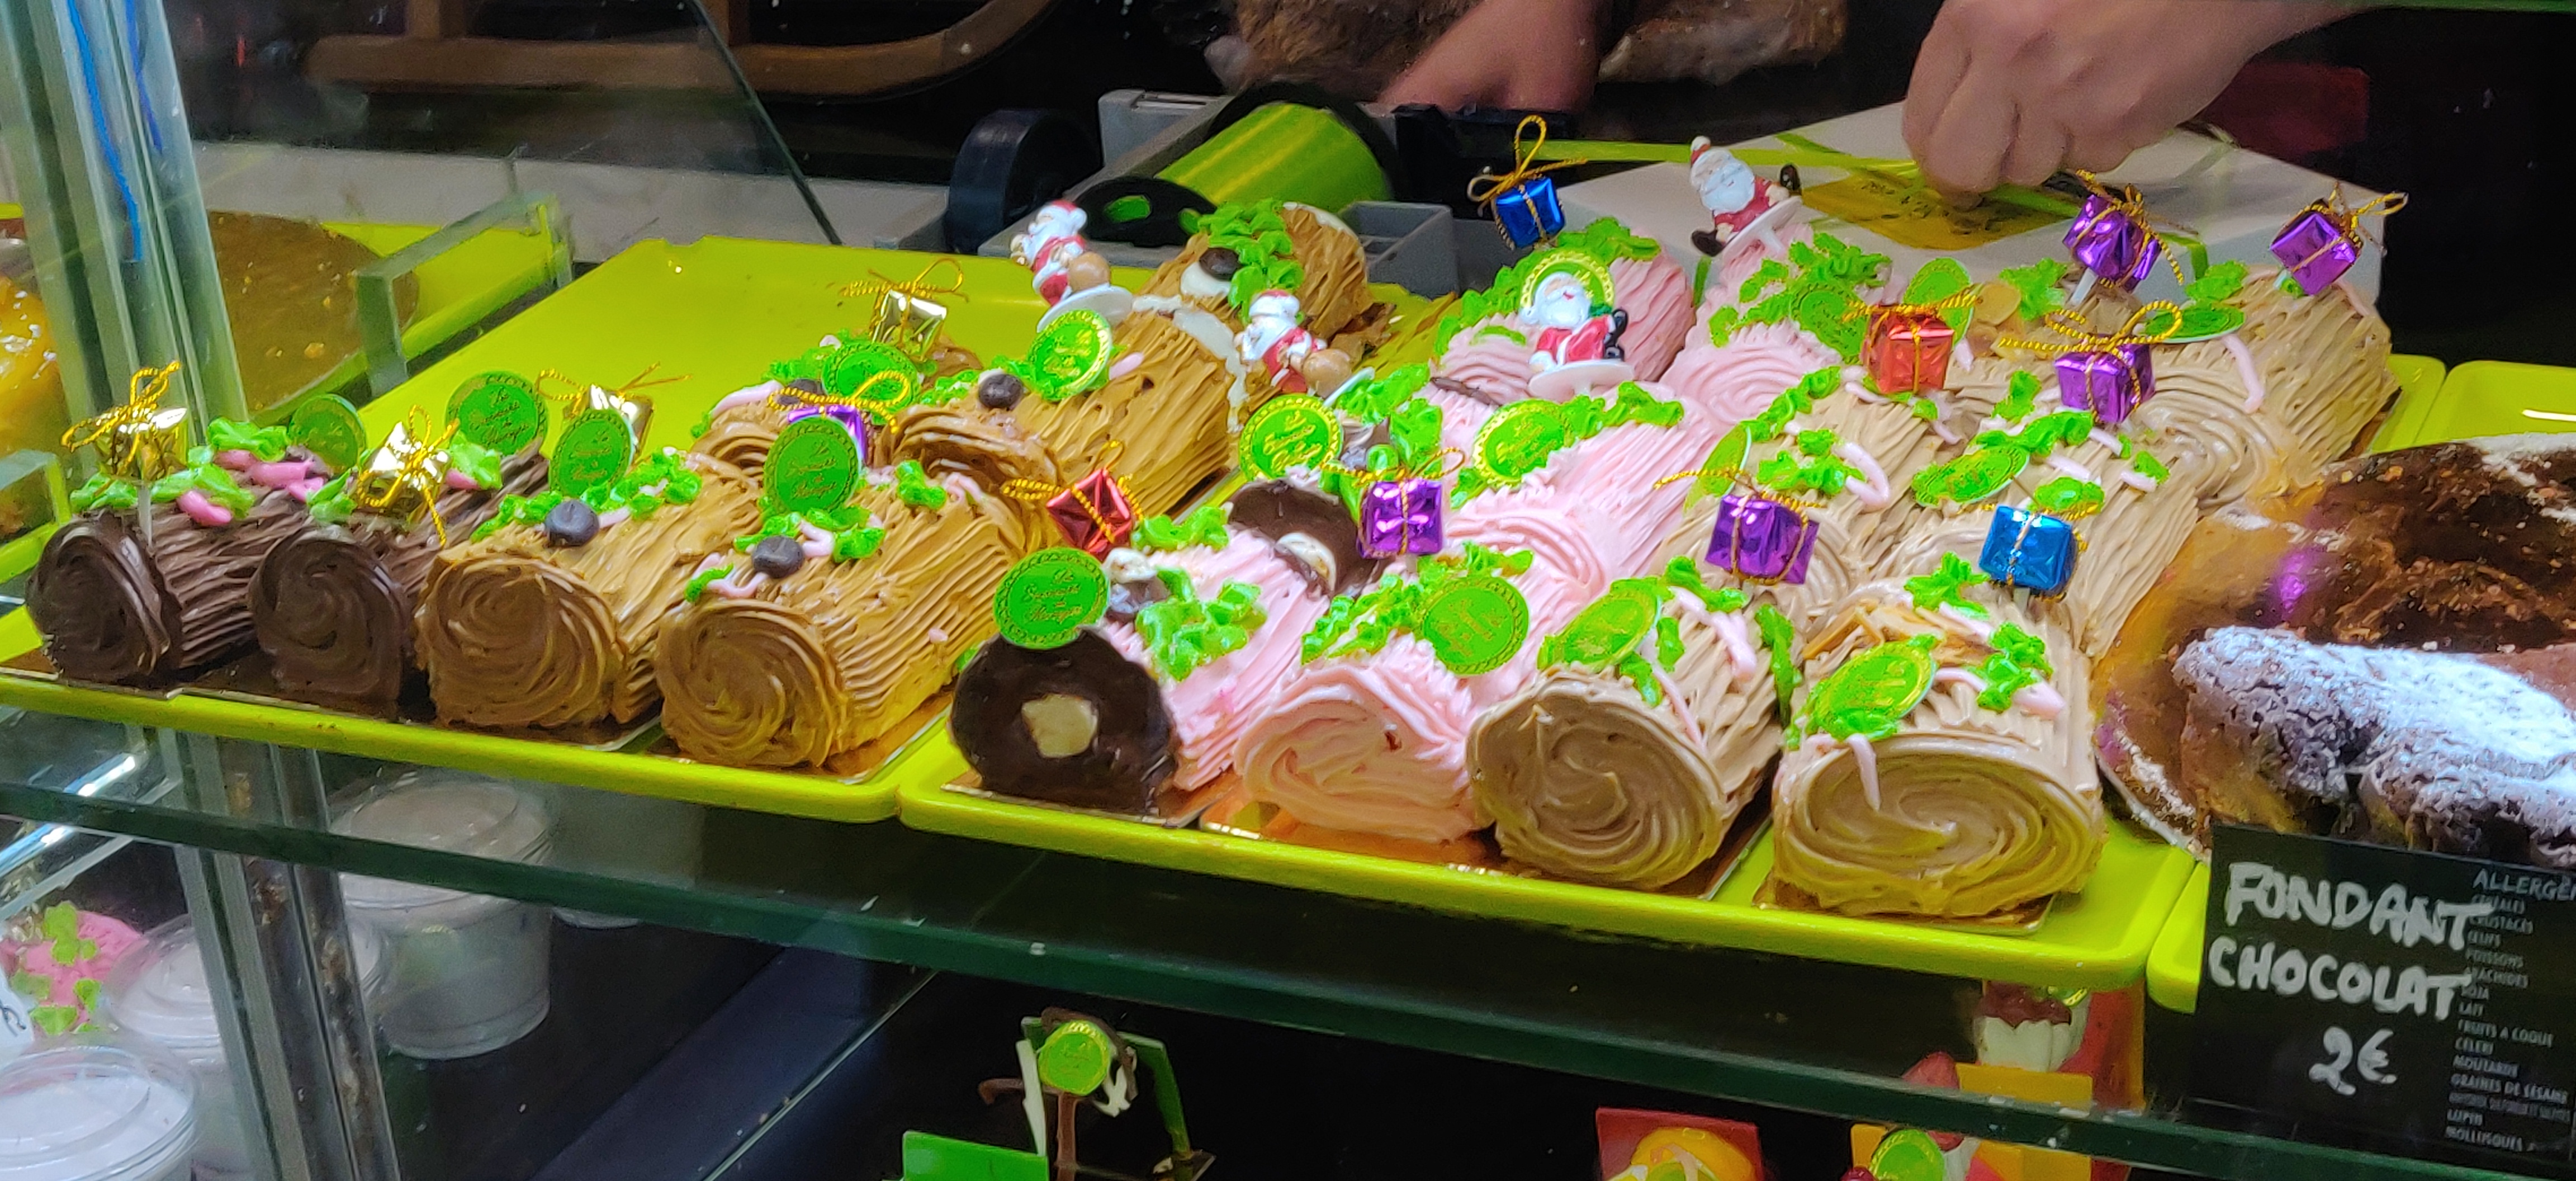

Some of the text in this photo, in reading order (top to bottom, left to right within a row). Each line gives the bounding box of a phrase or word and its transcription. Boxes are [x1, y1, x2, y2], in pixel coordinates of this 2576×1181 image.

[2224, 862, 2496, 950] FONDANT
[2209, 936, 2472, 1021] CHOCOLAT
[2308, 1027, 2397, 1095] 2€
